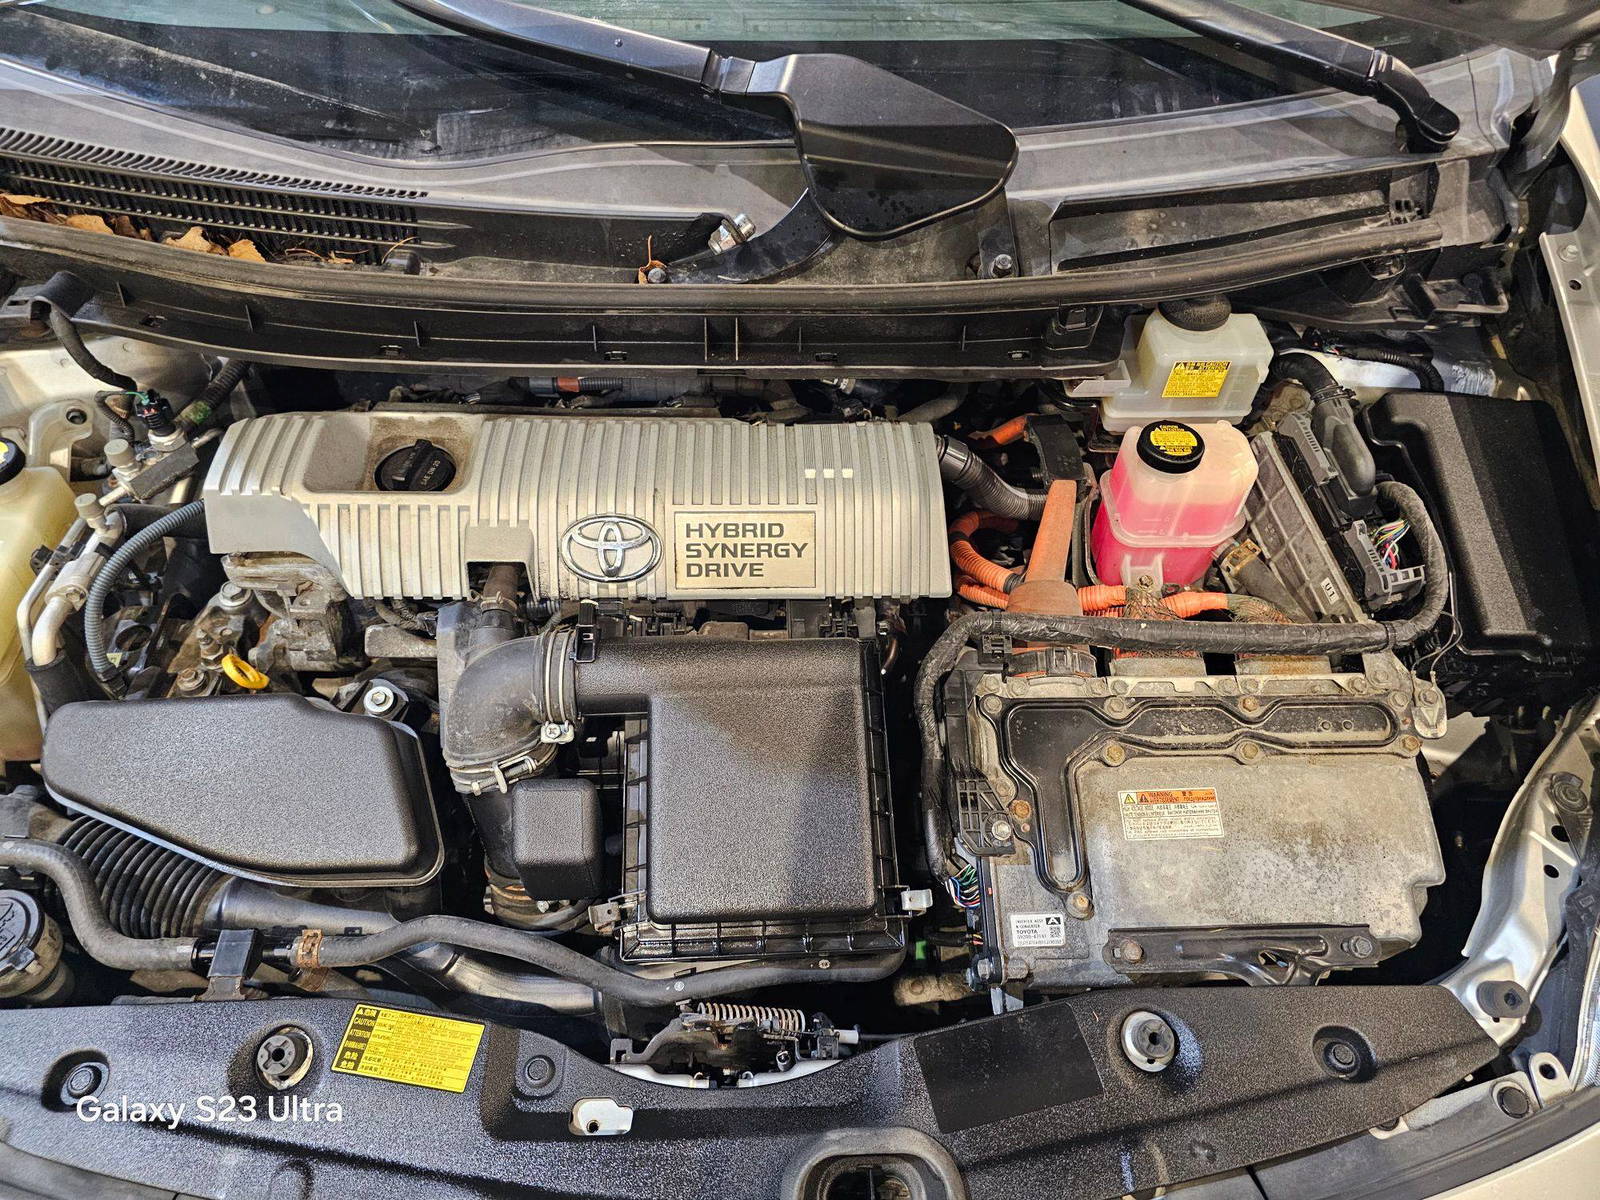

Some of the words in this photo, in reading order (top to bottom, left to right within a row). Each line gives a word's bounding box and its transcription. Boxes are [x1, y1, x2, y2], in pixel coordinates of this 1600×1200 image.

[686, 523, 784, 538] HYBRID
[686, 543, 809, 558] SYNERGY
[686, 563, 764, 577] DRIVE
[353, 1017, 375, 1027] CAUTION
